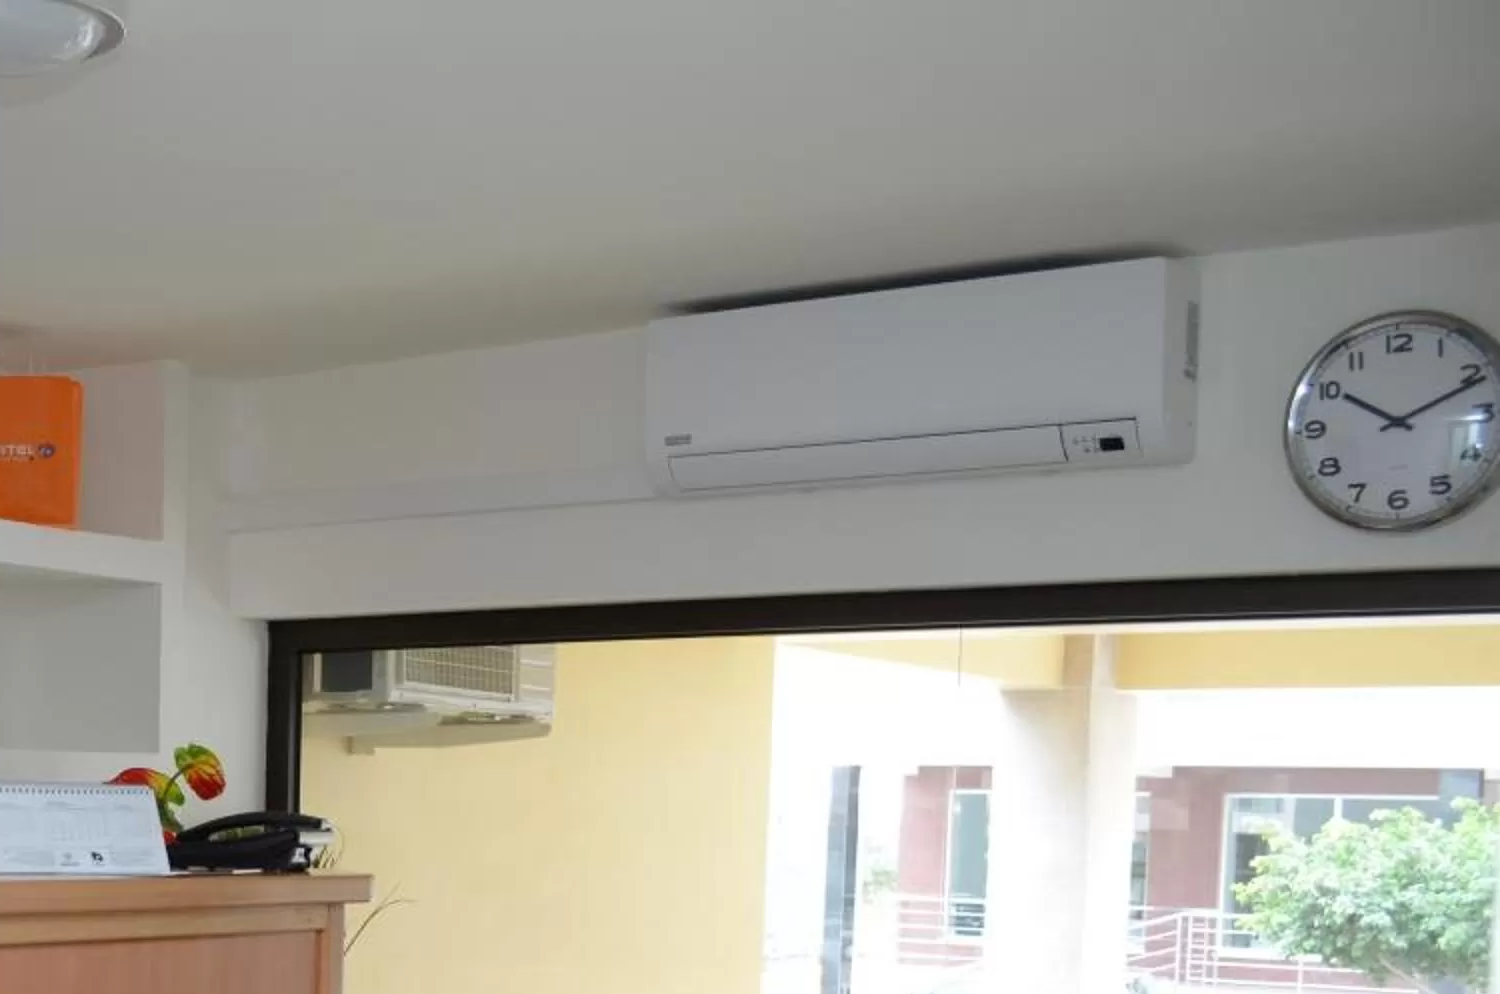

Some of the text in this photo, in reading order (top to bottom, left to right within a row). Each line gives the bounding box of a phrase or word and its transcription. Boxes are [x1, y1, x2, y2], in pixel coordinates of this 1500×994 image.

[1386, 333, 1413, 354] 12
[1437, 337, 1444, 358] 1
[1349, 352, 1364, 372] 11
[1460, 364, 1481, 385] 2
[1319, 381, 1341, 400] 10
[1472, 403, 1495, 423] 3
[1304, 420, 1326, 439] 9
[1460, 443, 1481, 462] 4
[1317, 457, 1341, 477] 8
[1347, 483, 1367, 503] 7
[1429, 474, 1452, 495] 5
[1387, 490, 1410, 510] 6
